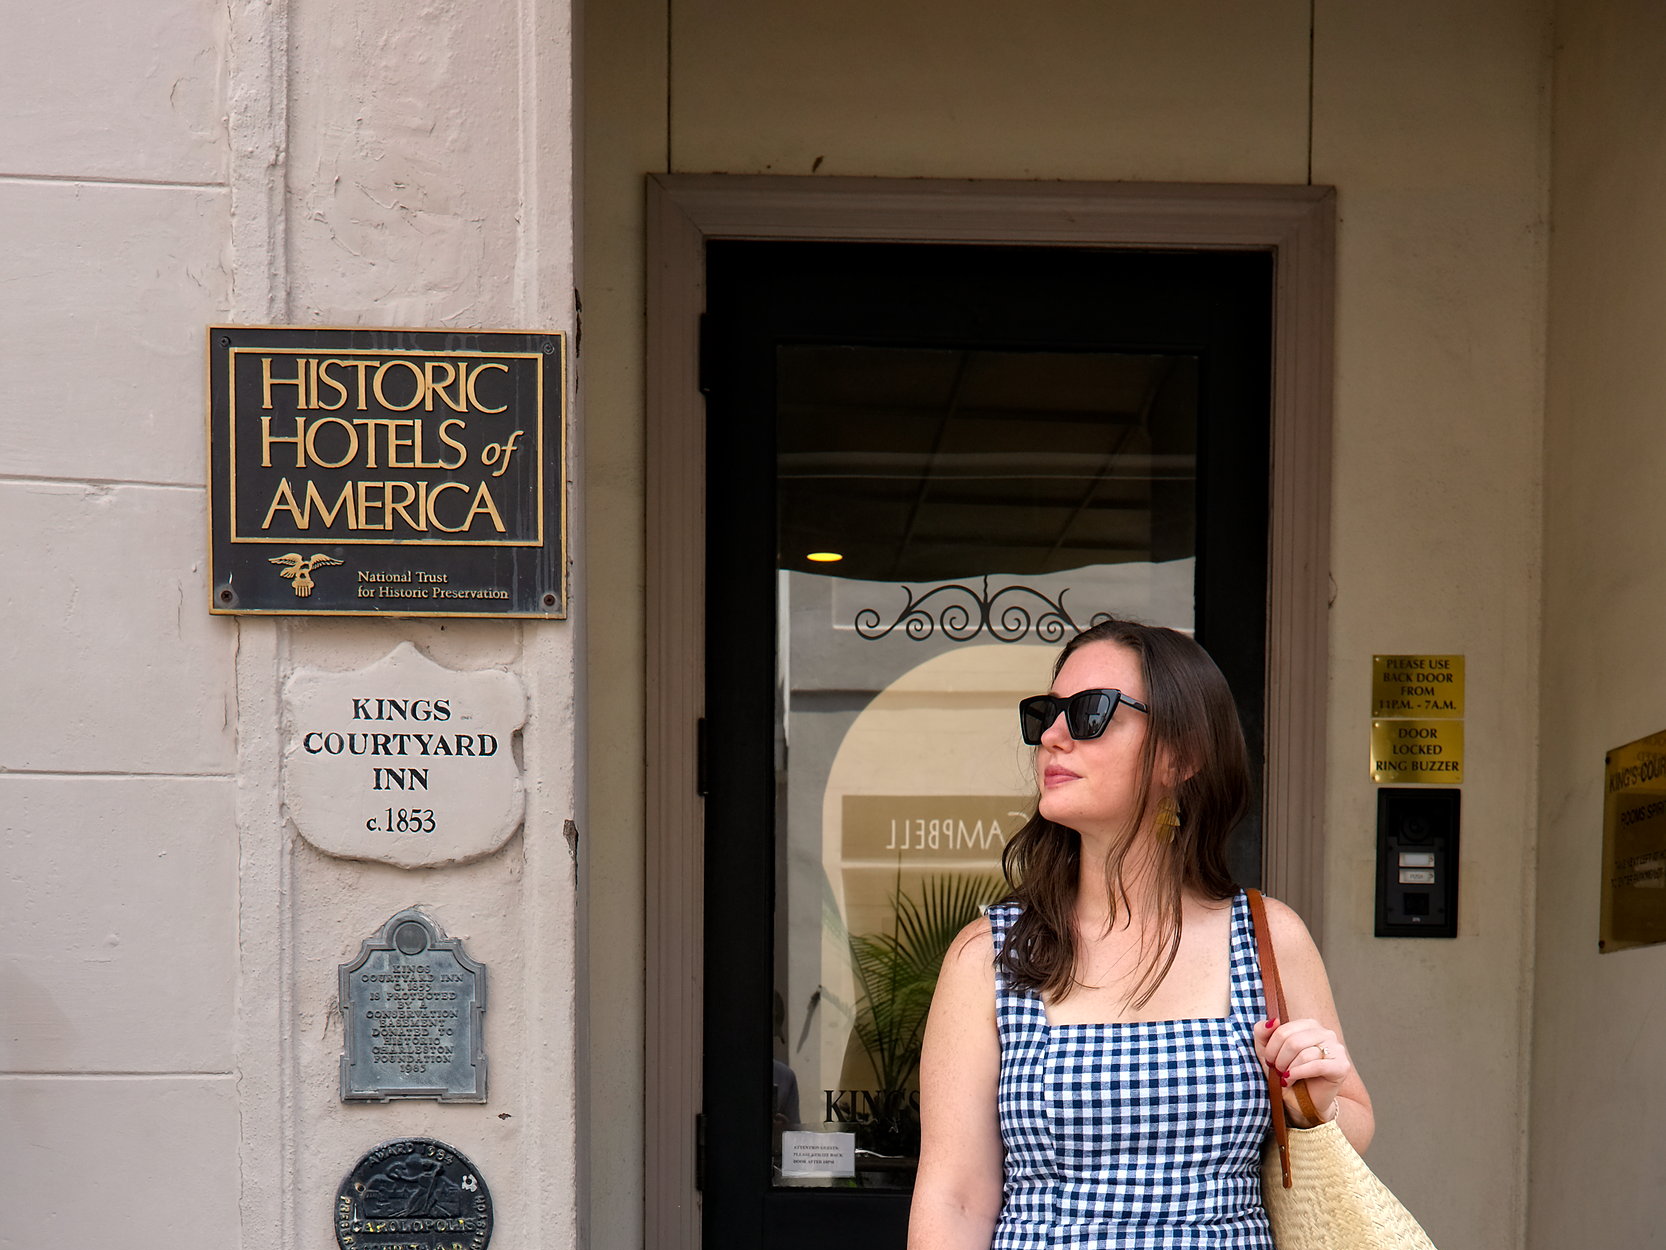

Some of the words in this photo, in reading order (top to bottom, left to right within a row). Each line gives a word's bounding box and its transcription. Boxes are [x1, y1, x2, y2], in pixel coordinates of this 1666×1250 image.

[261, 358, 508, 414] HISTORIC
[261, 417, 467, 470] HOTELS
[481, 430, 524, 476] of
[261, 477, 506, 532] AMERICA
[357, 571, 412, 583] National
[416, 572, 448, 583] Trust
[357, 586, 377, 598] for
[378, 586, 429, 599] Historic
[432, 587, 509, 599] Preservation
[1386, 659, 1425, 670] PLEASE
[1429, 659, 1450, 670] USE
[1383, 672, 1413, 683] BACK
[1416, 673, 1453, 683] DOOR
[1401, 686, 1435, 696] FROM
[352, 698, 451, 722] KINGS
[1425, 700, 1457, 710] 7A.M.
[1398, 728, 1437, 739] DOOR
[303, 732, 498, 757] COURTYARD
[1393, 744, 1443, 755] LOCKED
[1376, 761, 1408, 771] RING
[1411, 761, 1459, 772] BUZZER
[372, 767, 429, 791] INN
[366, 807, 436, 834] c.1853
[392, 964, 431, 974] KINGS
[361, 974, 436, 983] COURTYARD
[440, 974, 464, 983] INN
[369, 992, 380, 1001] IS
[386, 992, 457, 1001] PROTECTED
[397, 1001, 413, 1010] BY
[419, 1001, 428, 1010] A
[366, 1010, 459, 1019] CONSERVATION
[379, 1019, 446, 1028] EASEMENT
[371, 1028, 430, 1037] DONATED
[437, 1028, 454, 1037] TO
[382, 1037, 441, 1046] HISTORIC
[371, 1046, 455, 1055] CHARLESTON
[373, 1055, 451, 1064] FOUNDATION
[368, 1143, 414, 1169] AWARD
[351, 1218, 477, 1234] CAROLOPOLIS
